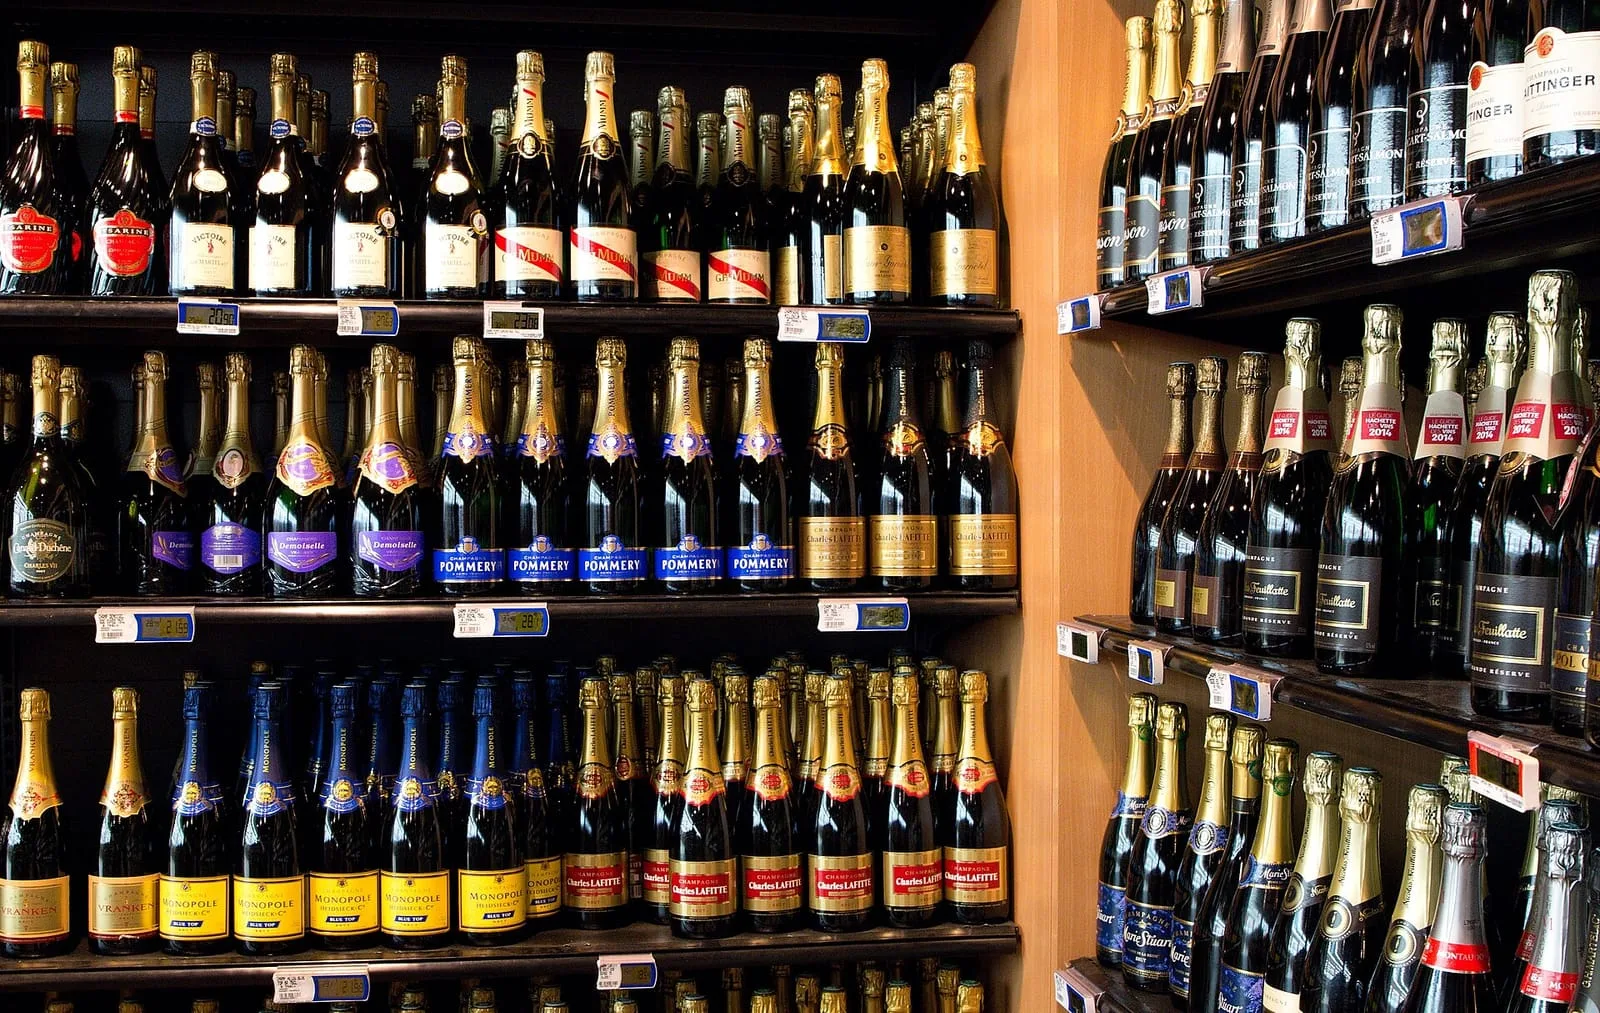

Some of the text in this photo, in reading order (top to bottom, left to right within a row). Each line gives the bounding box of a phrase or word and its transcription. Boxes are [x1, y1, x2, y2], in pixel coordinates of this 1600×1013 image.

[524, 98, 534, 127] MUMM
[597, 100, 607, 130] MUMM
[663, 131, 671, 158] MUMM
[733, 129, 742, 158] MUMM
[192, 232, 227, 246] VICTOIRE
[465, 374, 473, 416] POMMERY
[608, 374, 616, 417] POMMERY
[1368, 428, 1392, 437] 2014
[1476, 431, 1493, 439] 2014
[1512, 425, 1531, 435] 2014
[1431, 433, 1454, 442] 2014
[806, 534, 833, 543] Charles
[874, 533, 930, 542] Charles LAFITTE
[956, 532, 1011, 541] Charles LAFITTE
[279, 542, 325, 550] Demoiselle
[374, 541, 417, 549] Demoiselle
[440, 561, 496, 572] POMMERY
[513, 560, 569, 571] POMMERY
[584, 559, 640, 571] POMMERY
[662, 558, 717, 570] POMMERY
[734, 558, 789, 570] POMMERY
[1251, 581, 1289, 596] Feuillatte
[1320, 592, 1356, 608] Feuillatte
[1260, 617, 1291, 625] RÉSERVE
[1478, 620, 1527, 639] Feuillatte
[1326, 631, 1359, 640] RÉSERVE
[1490, 668, 1531, 678] RÉSERVE
[28, 730, 36, 772] VRANKEN
[189, 728, 198, 773] MONOPOLE
[262, 729, 270, 773] MONOPOLE
[339, 727, 347, 771] MONOPOLE
[409, 727, 417, 770] MONOPOLE
[567, 876, 621, 887] Charles LAFITTE
[643, 872, 663, 882] Charles
[756, 872, 797, 880] CHAMPAGNE
[825, 872, 866, 880] CHAMPAGNE
[896, 876, 923, 886] Charles
[944, 871, 998, 882] Charles LAFITTE
[749, 879, 802, 890] Charles LAFITTE
[817, 878, 871, 890] Charles LAFITTE
[470, 889, 523, 900] MONOPOLE
[672, 885, 728, 896] Charles LAFITTE
[162, 898, 217, 907] MONOPOLE
[238, 899, 294, 909] MONOPOLE
[315, 894, 371, 904] MONOPOLE
[385, 894, 440, 904] MONOPOLE
[1, 906, 57, 916] VRANKEN
[97, 903, 154, 913] VRANKEN
